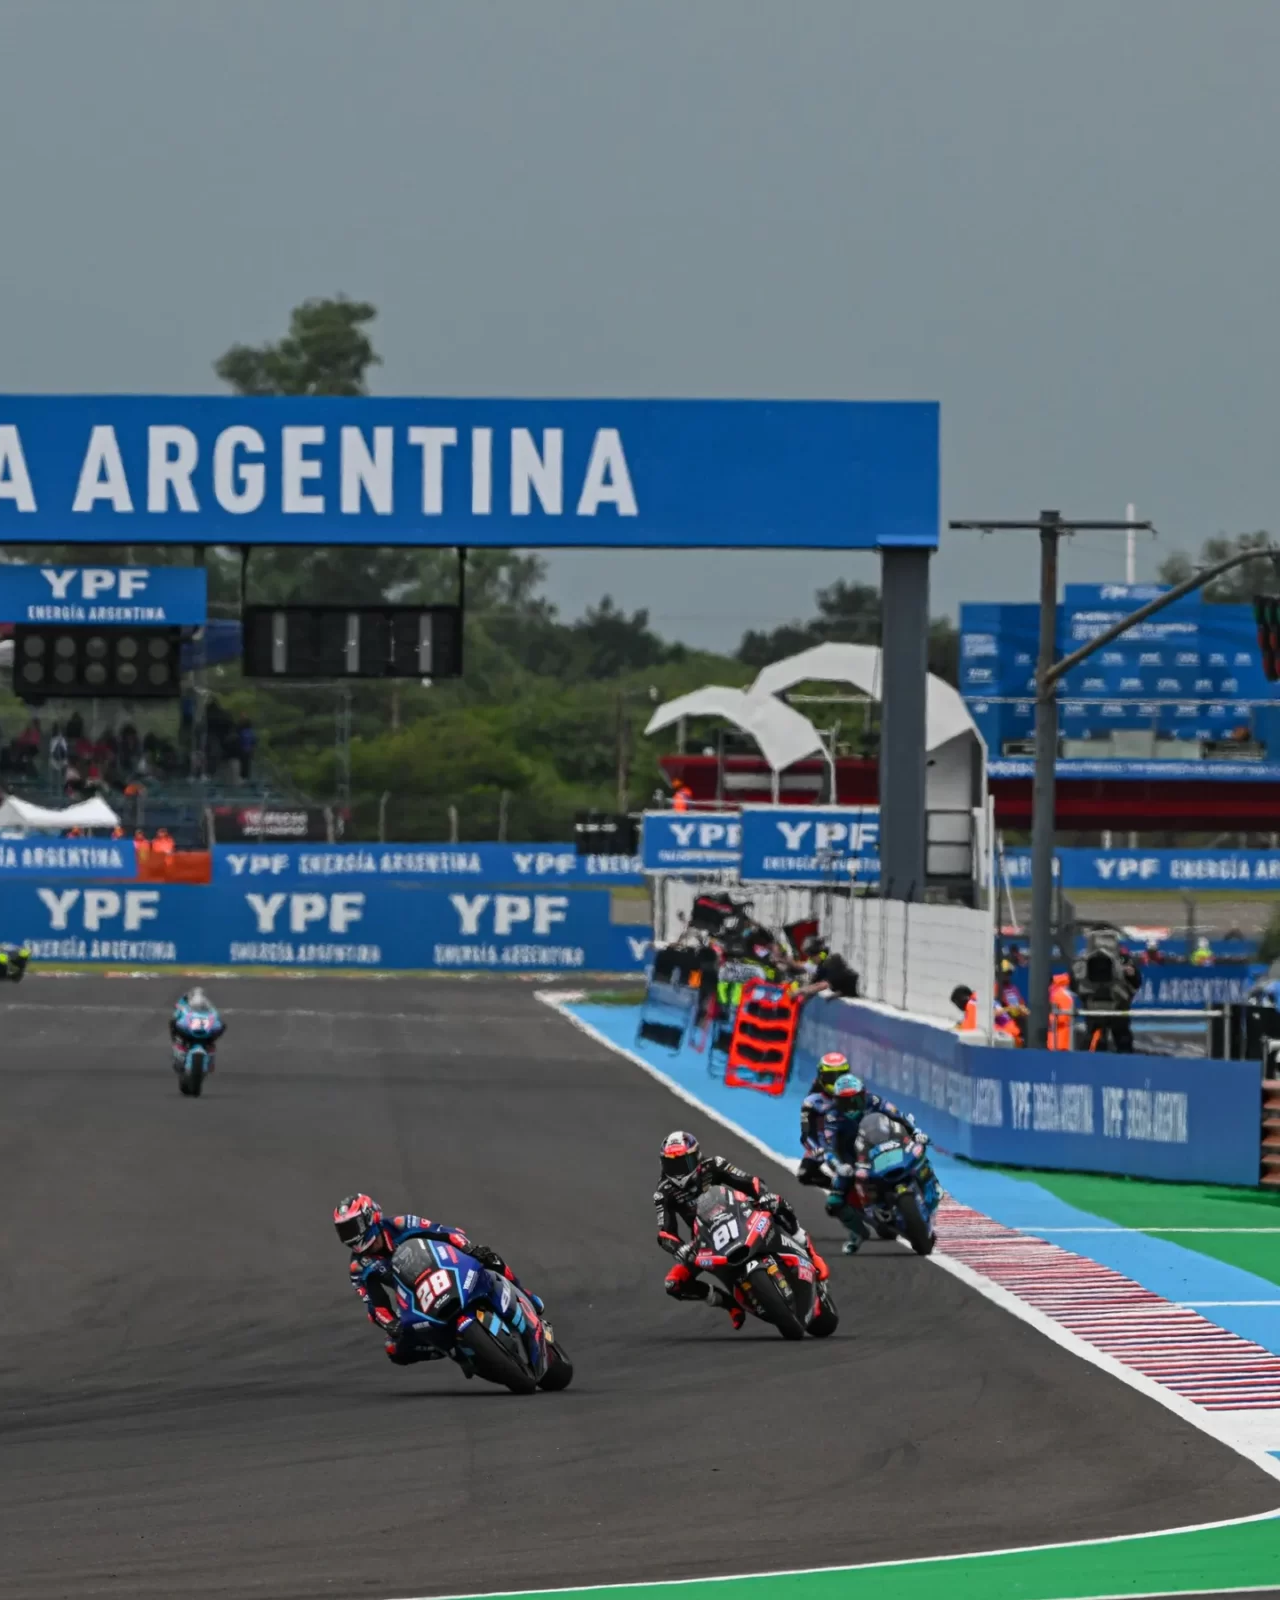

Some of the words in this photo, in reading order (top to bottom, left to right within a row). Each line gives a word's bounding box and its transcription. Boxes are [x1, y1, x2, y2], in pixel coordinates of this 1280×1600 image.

[72, 425, 638, 516] ARGENTINA
[41, 569, 149, 599] YPF
[28, 604, 85, 620] ENERGÍA
[88, 607, 165, 620] ARGENTINA
[776, 820, 879, 852] YPF
[22, 847, 122, 868] ARGENTINA
[226, 854, 288, 874] YPF
[380, 852, 481, 873] ARGENTINA
[514, 852, 576, 874] YPF
[1096, 858, 1158, 879] YPF
[1170, 854, 1250, 879] ENERGÍA
[38, 888, 160, 931] YPF
[246, 892, 365, 933] YPF
[450, 894, 568, 935] YPF
[90, 940, 176, 960] ARGENTINA
[296, 944, 380, 963] ARGENTINA
[500, 945, 584, 966] ARGENTINA
[1158, 979, 1250, 1003] ARGENTIN
[712, 1219, 740, 1251] 81
[416, 1269, 451, 1313] 28
